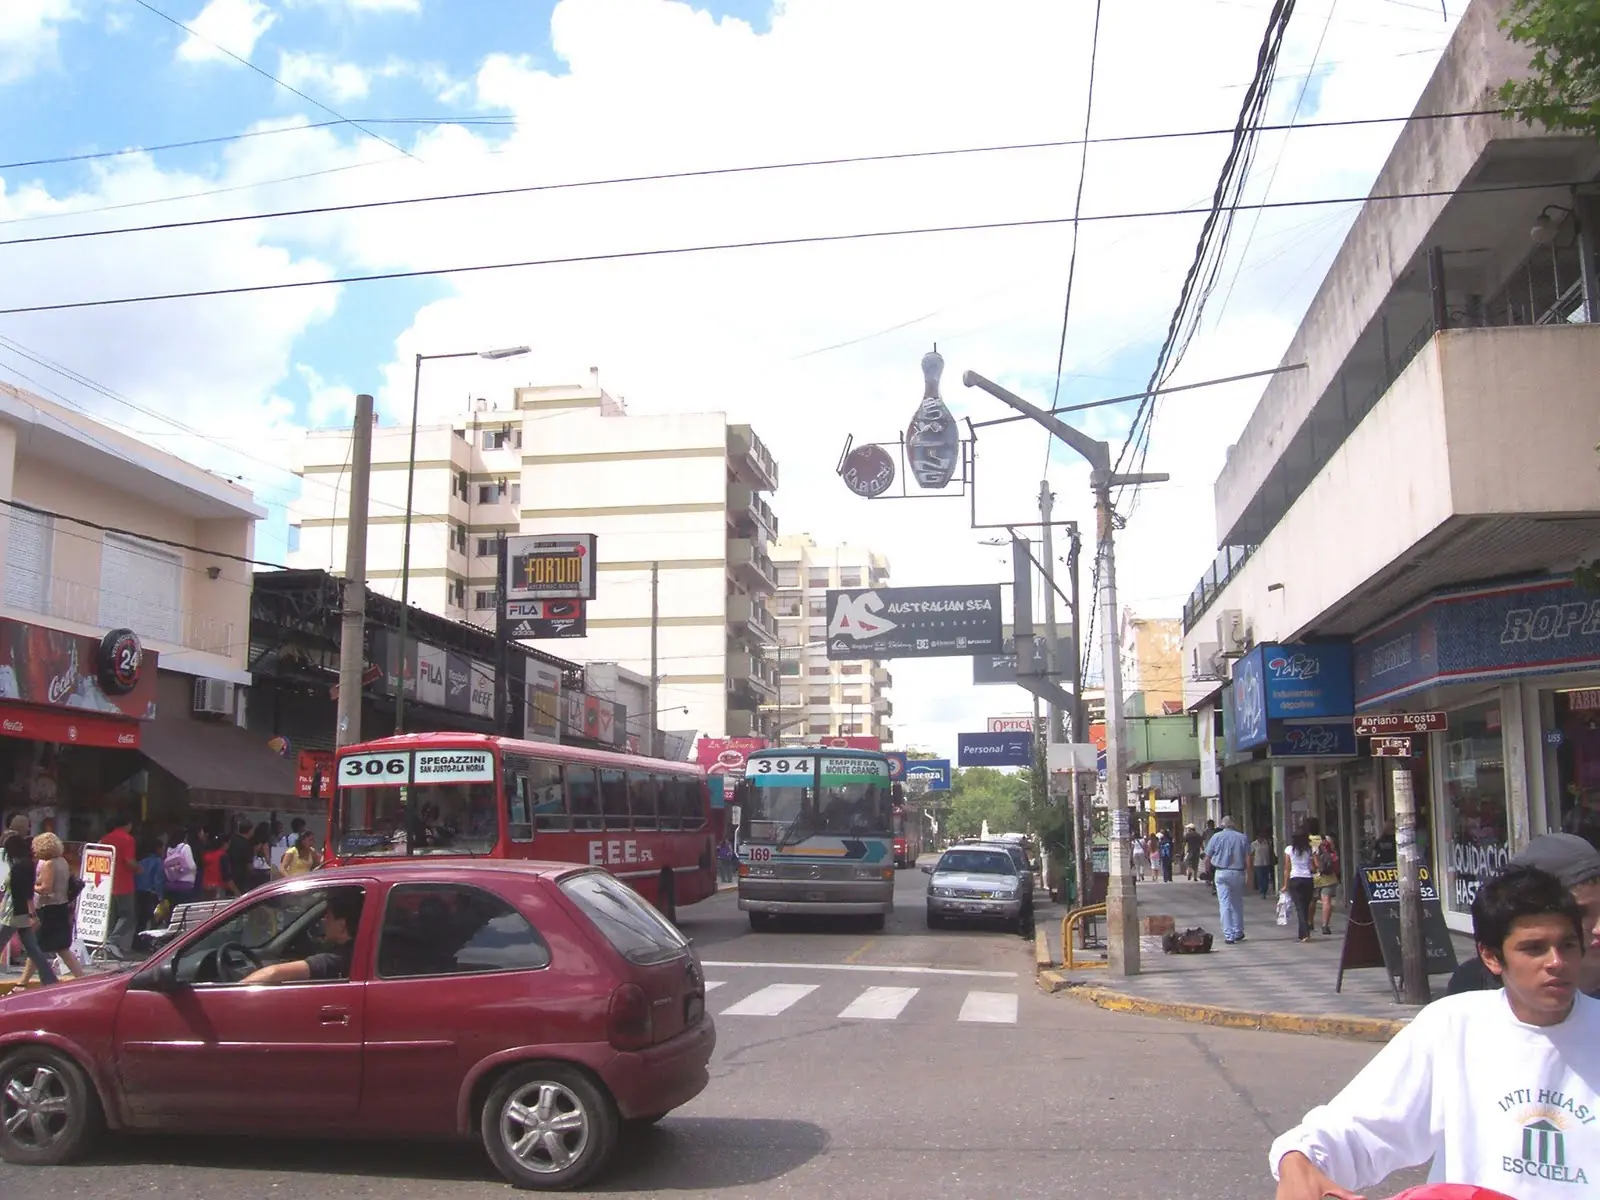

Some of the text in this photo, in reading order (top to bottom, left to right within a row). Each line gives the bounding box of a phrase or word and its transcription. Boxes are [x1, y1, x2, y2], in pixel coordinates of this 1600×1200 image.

[524, 557, 581, 583] FORUM
[509, 605, 538, 616] FILA
[887, 599, 992, 614] AUSTRALIAN SEA
[120, 649, 138, 671] 24
[420, 660, 443, 686] FILA
[1361, 714, 1437, 726] Mariano Acosta
[963, 744, 1004, 754] Personal
[345, 758, 405, 776] 306
[420, 755, 486, 765] SPEGAZZINI
[758, 759, 810, 774] 394
[829, 759, 877, 767] EMPRESA
[420, 765, 432, 774] SAN
[465, 763, 485, 773] NORIA
[826, 765, 880, 775] MONTE GRANDE
[750, 847, 770, 861] 169
[87, 855, 110, 874] CAMBIO
[86, 893, 105, 901] EUROS
[81, 900, 108, 910] CHEQUES
[1498, 1089, 1596, 1125] INTI HUASI
[1502, 1156, 1589, 1184] ESCUELA
